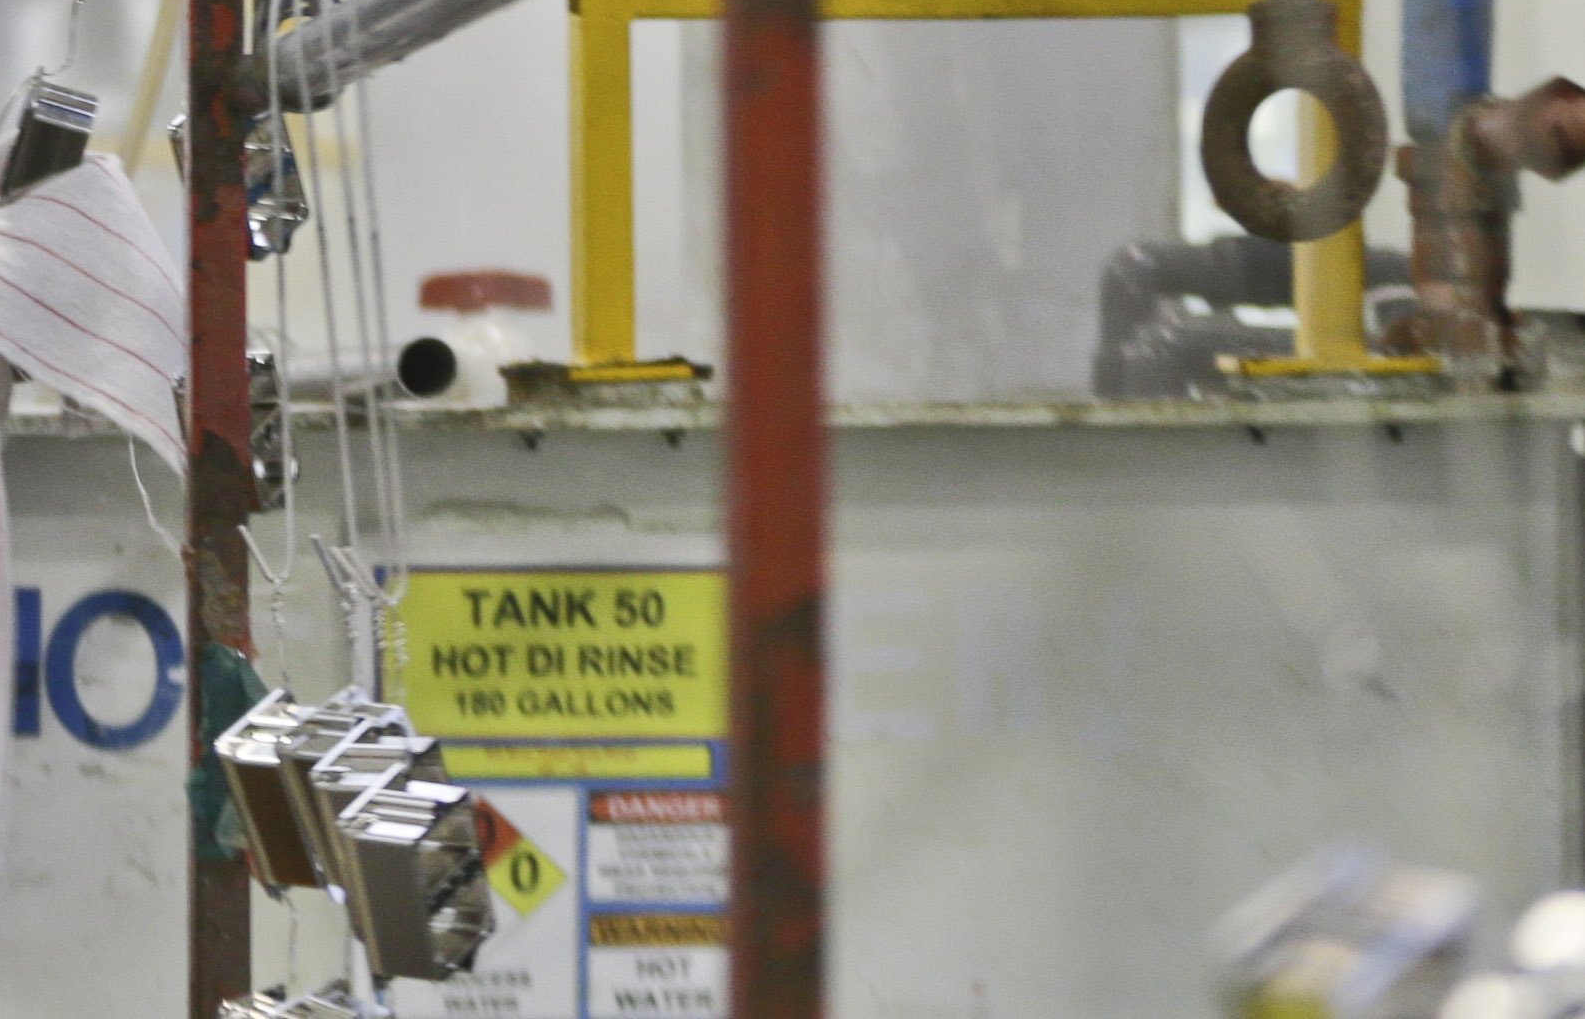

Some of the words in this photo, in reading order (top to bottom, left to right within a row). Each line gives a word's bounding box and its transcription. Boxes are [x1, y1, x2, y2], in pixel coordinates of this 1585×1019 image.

[463, 589, 596, 628] TANK
[613, 589, 666, 628] 50
[431, 645, 513, 677] HOT
[527, 645, 566, 676] DI
[578, 645, 697, 678] RINSE
[518, 691, 675, 719] GALLONS
[607, 795, 722, 822] DANGER
[510, 853, 539, 896] 0
[636, 956, 690, 980] HOT
[613, 987, 712, 1014] WATER
